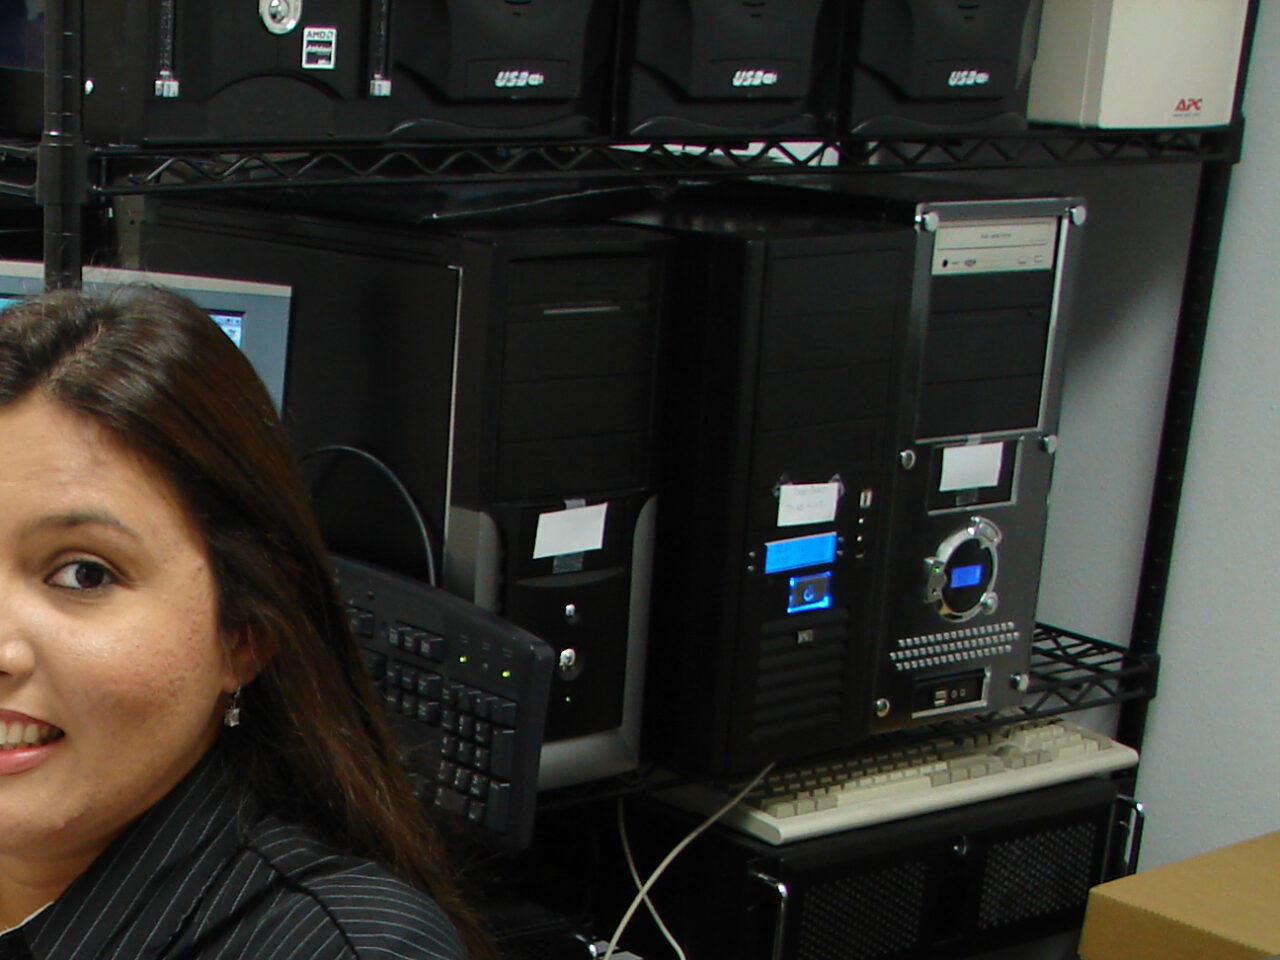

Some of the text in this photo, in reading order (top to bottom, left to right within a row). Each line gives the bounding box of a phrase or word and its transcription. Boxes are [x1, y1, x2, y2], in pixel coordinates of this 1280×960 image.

[495, 71, 529, 88] USB
[732, 70, 764, 87] USB
[948, 70, 977, 86] USB
[1174, 98, 1202, 111] APC
